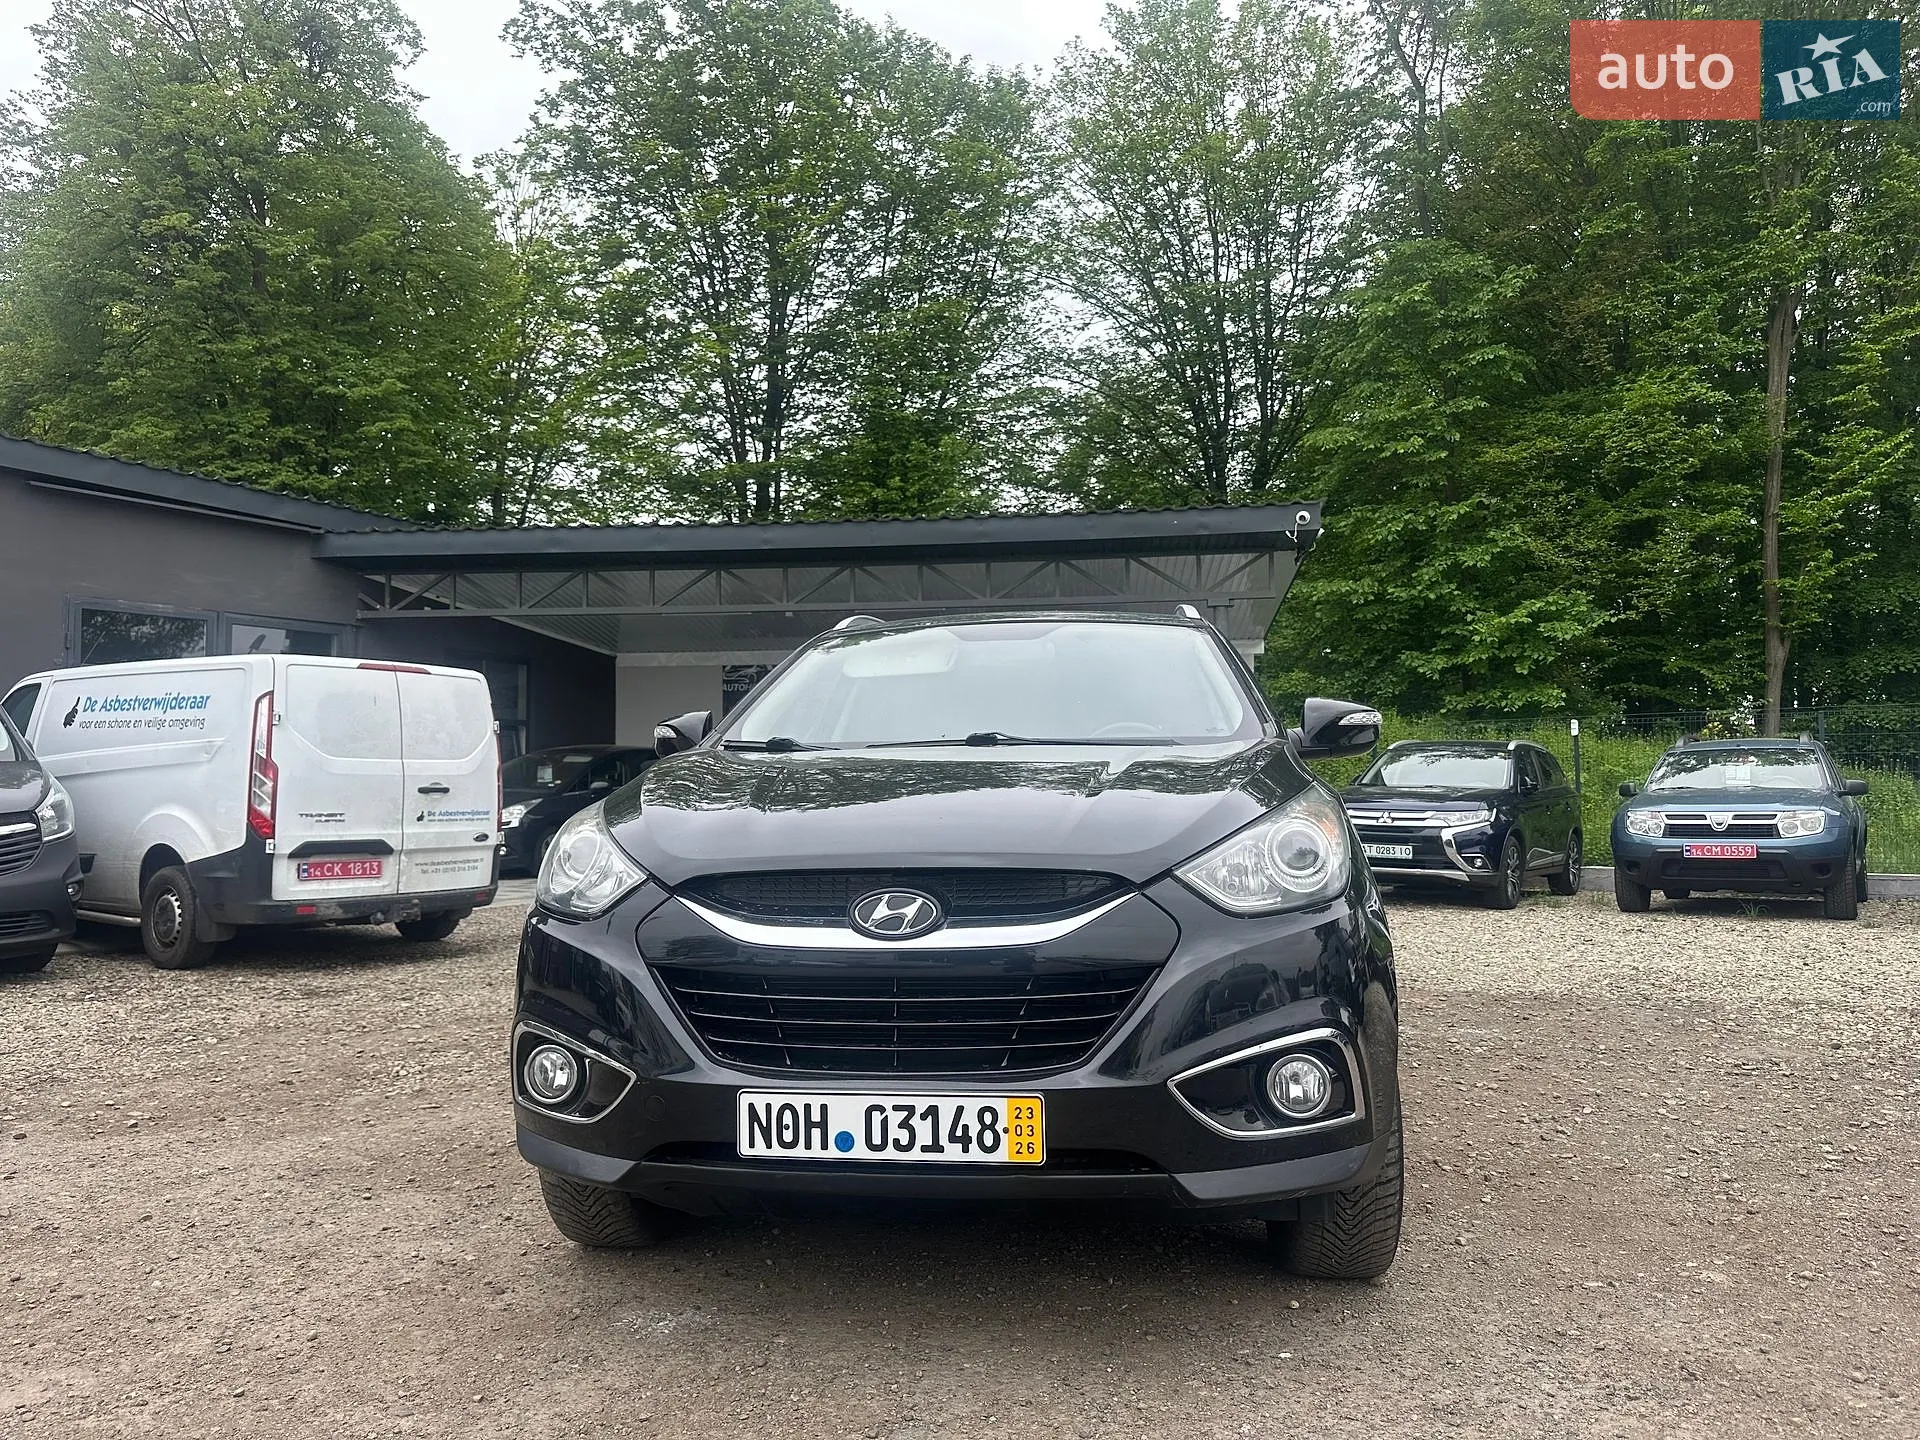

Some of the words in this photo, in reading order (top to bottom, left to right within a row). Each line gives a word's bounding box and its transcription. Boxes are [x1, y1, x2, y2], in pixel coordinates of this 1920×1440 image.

[722, 683, 755, 692] AUTOH
[82, 696, 98, 712] De
[99, 691, 212, 714] Asbestverwijderaar
[79, 719, 93, 729] voor
[94, 720, 106, 729] een
[107, 717, 131, 729] schone
[133, 719, 142, 729] en
[144, 716, 166, 730] veilige
[168, 715, 206, 730] omgeving
[1375, 846, 1396, 855] 0283
[1691, 848, 1702, 856] 14
[1703, 845, 1721, 856] CM
[1724, 846, 1752, 856] 0559
[309, 867, 321, 877] 14
[323, 863, 343, 876] CK
[347, 861, 379, 875] 1813
[1014, 1106, 1035, 1120] 23
[748, 1102, 829, 1150] NOH
[864, 1104, 1001, 1154] 03148
[1014, 1124, 1035, 1137] 03
[1015, 1141, 1035, 1155] 26
